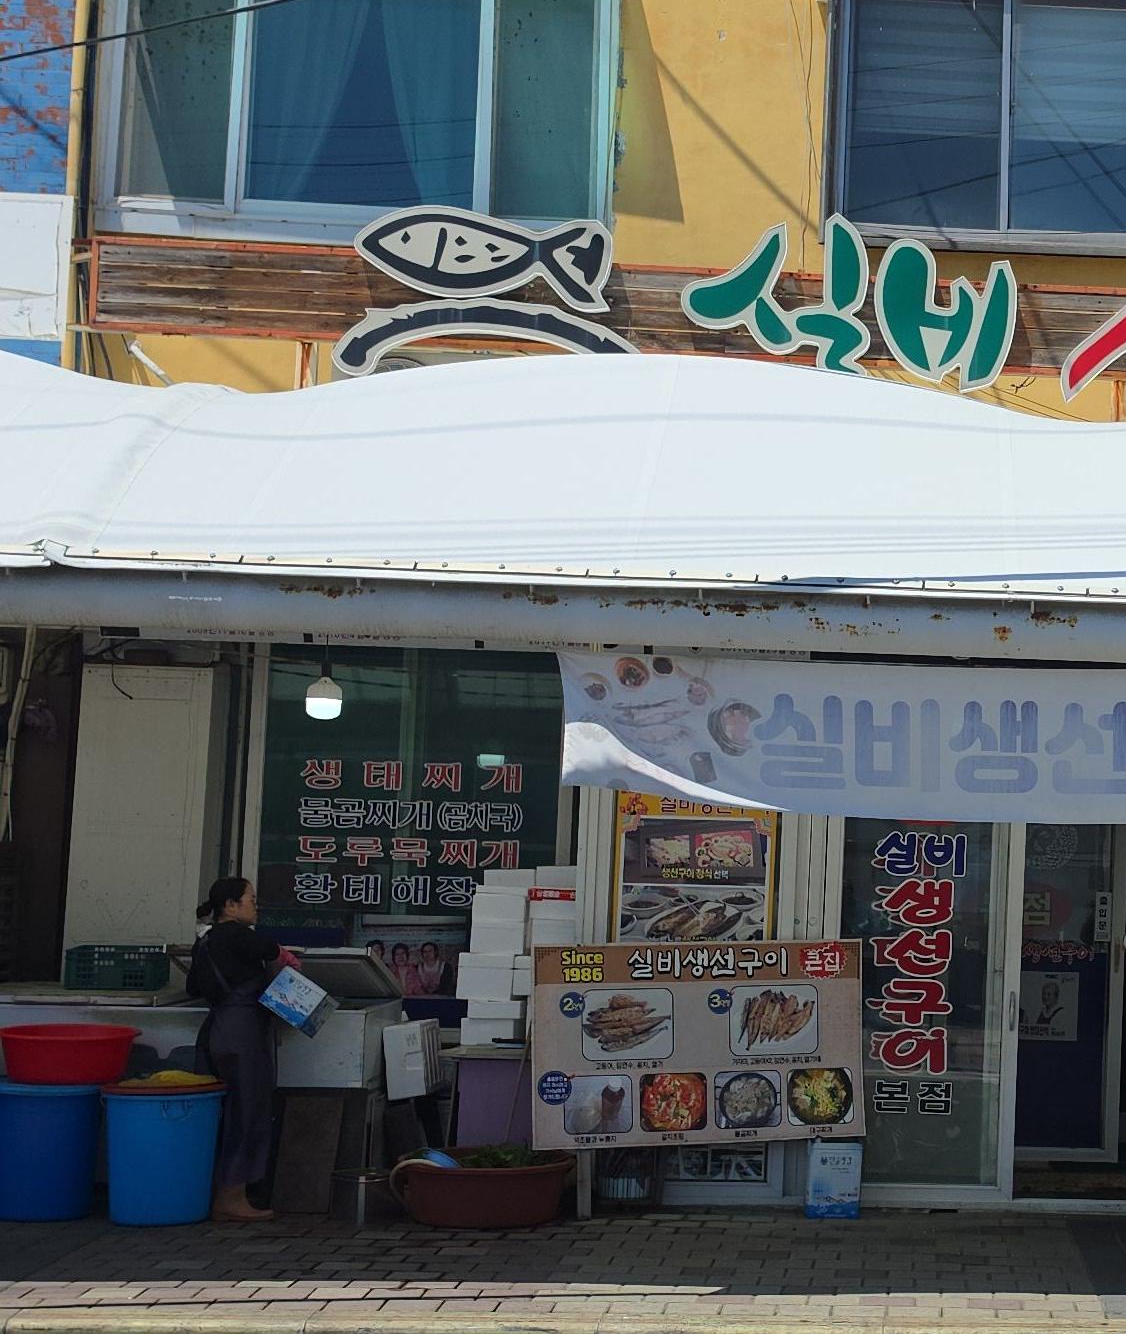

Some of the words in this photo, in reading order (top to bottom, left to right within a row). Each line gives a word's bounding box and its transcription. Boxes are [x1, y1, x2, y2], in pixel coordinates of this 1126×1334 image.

[684, 215, 1016, 389] 실비
[875, 831, 967, 878] 실비
[294, 873, 479, 907] 황태해장
[561, 948, 604, 966] Since
[627, 945, 788, 979] 실비생선구이
[804, 950, 841, 973] 큰집
[561, 966, 604, 983] 1986
[873, 1080, 953, 1115] 본점
